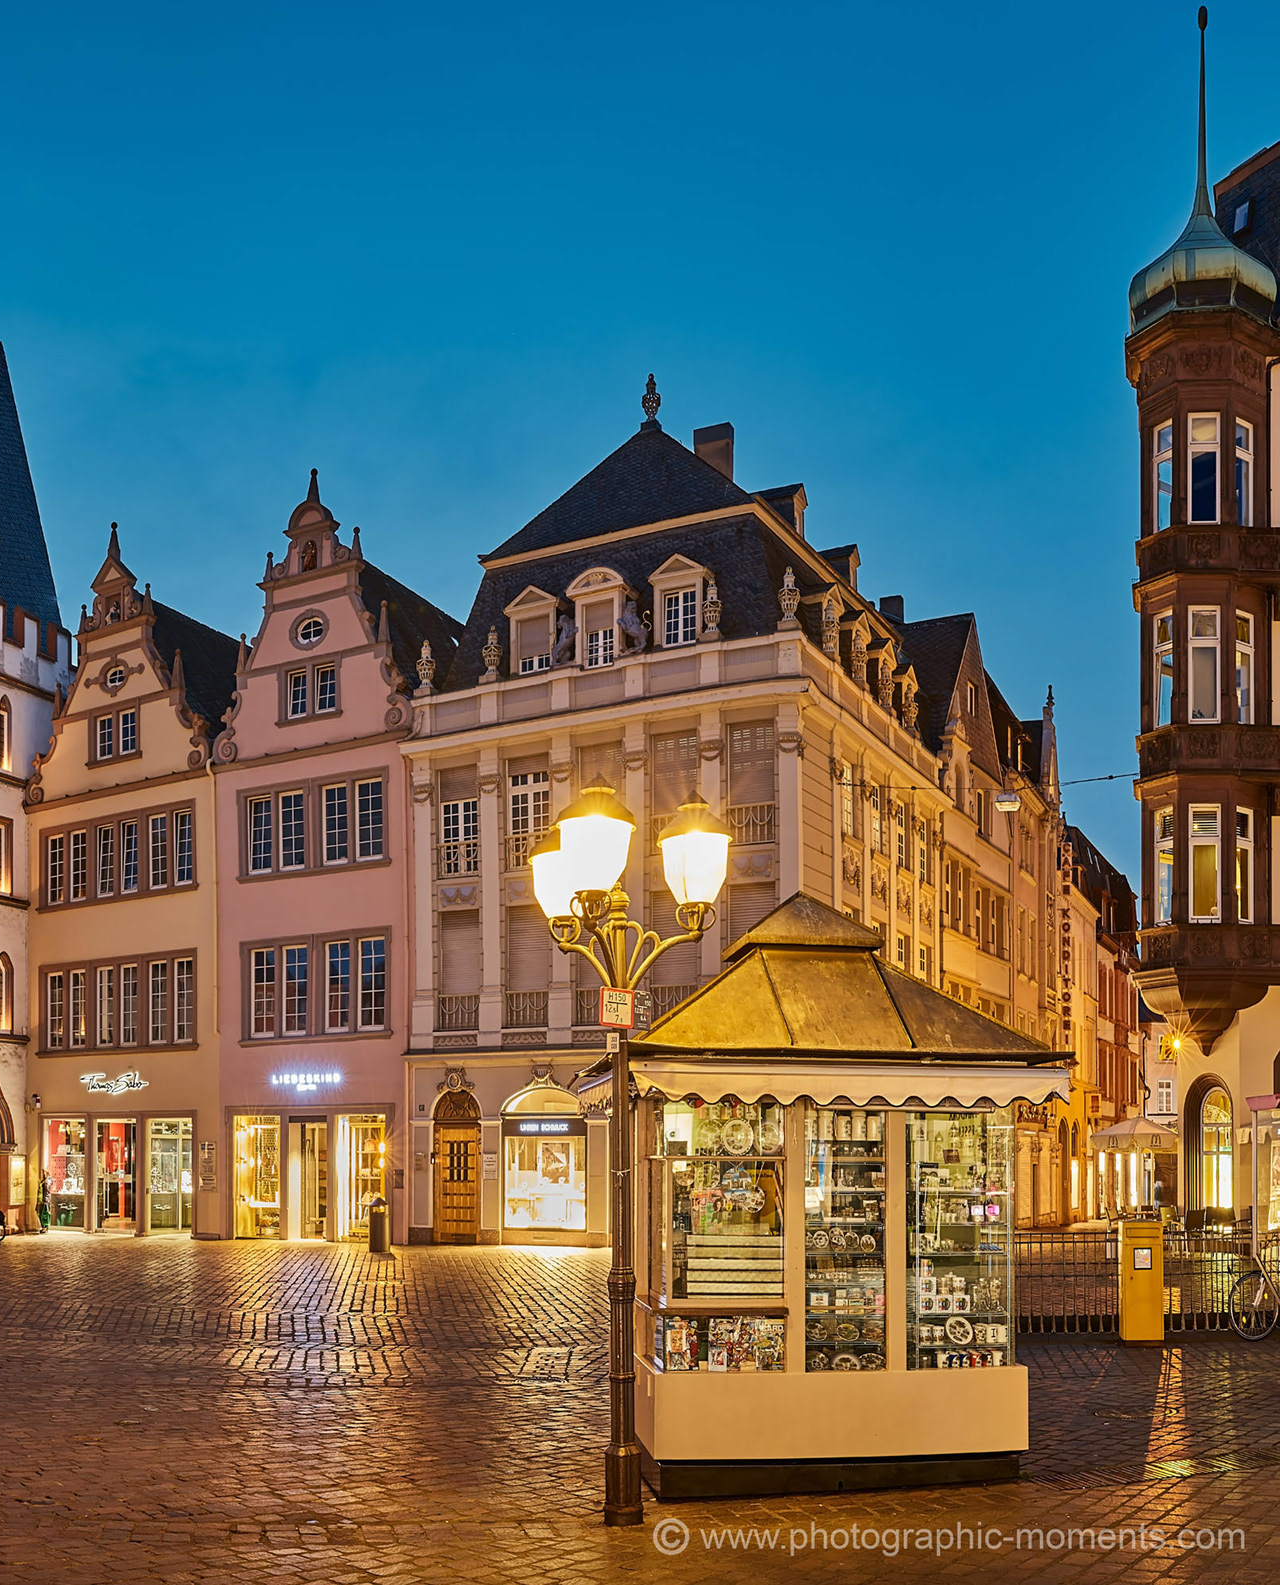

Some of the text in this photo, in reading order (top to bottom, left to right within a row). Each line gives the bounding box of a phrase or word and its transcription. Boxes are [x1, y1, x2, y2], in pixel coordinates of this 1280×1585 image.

[1061, 907, 1072, 1045] KONDITOREI
[80, 1070, 149, 1094] Thomas Sabo
[272, 1072, 341, 1085] LIEBESKIND
